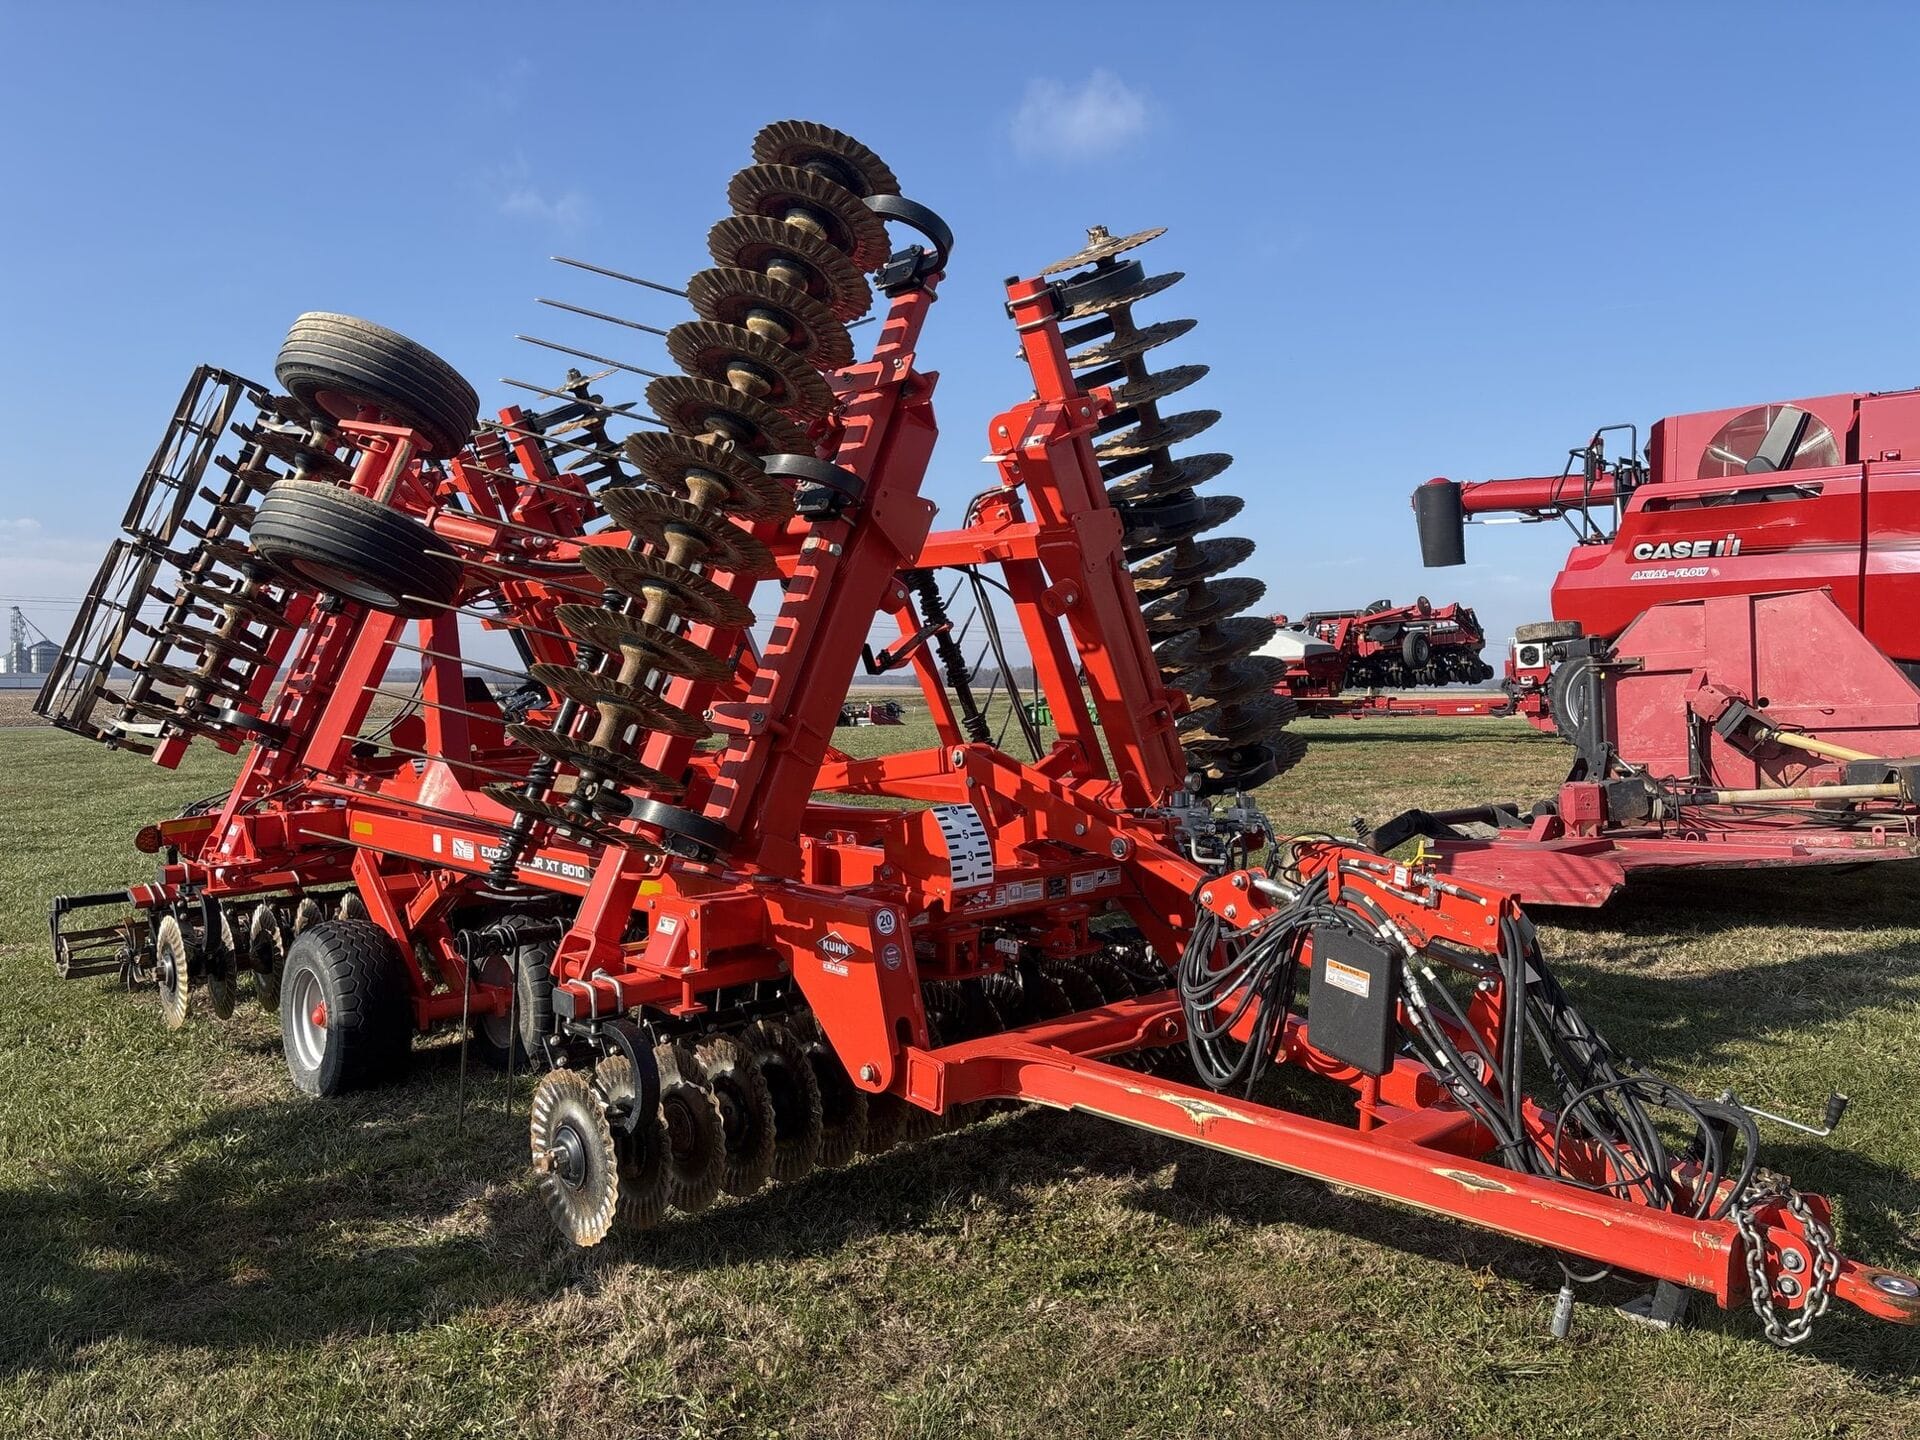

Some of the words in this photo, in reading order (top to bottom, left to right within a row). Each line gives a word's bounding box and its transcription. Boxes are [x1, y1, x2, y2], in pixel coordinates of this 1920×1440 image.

[1632, 539, 1713, 560] CASE
[1630, 566, 1709, 581] AXIAL-FLOW
[950, 806, 959, 816] 8
[962, 829, 970, 840] 5
[967, 850, 975, 861] 3
[546, 859, 558, 872] XT
[561, 863, 585, 878] 8010
[970, 871, 975, 883] 1
[878, 914, 892, 927] 20
[822, 940, 849, 956] KUHN
